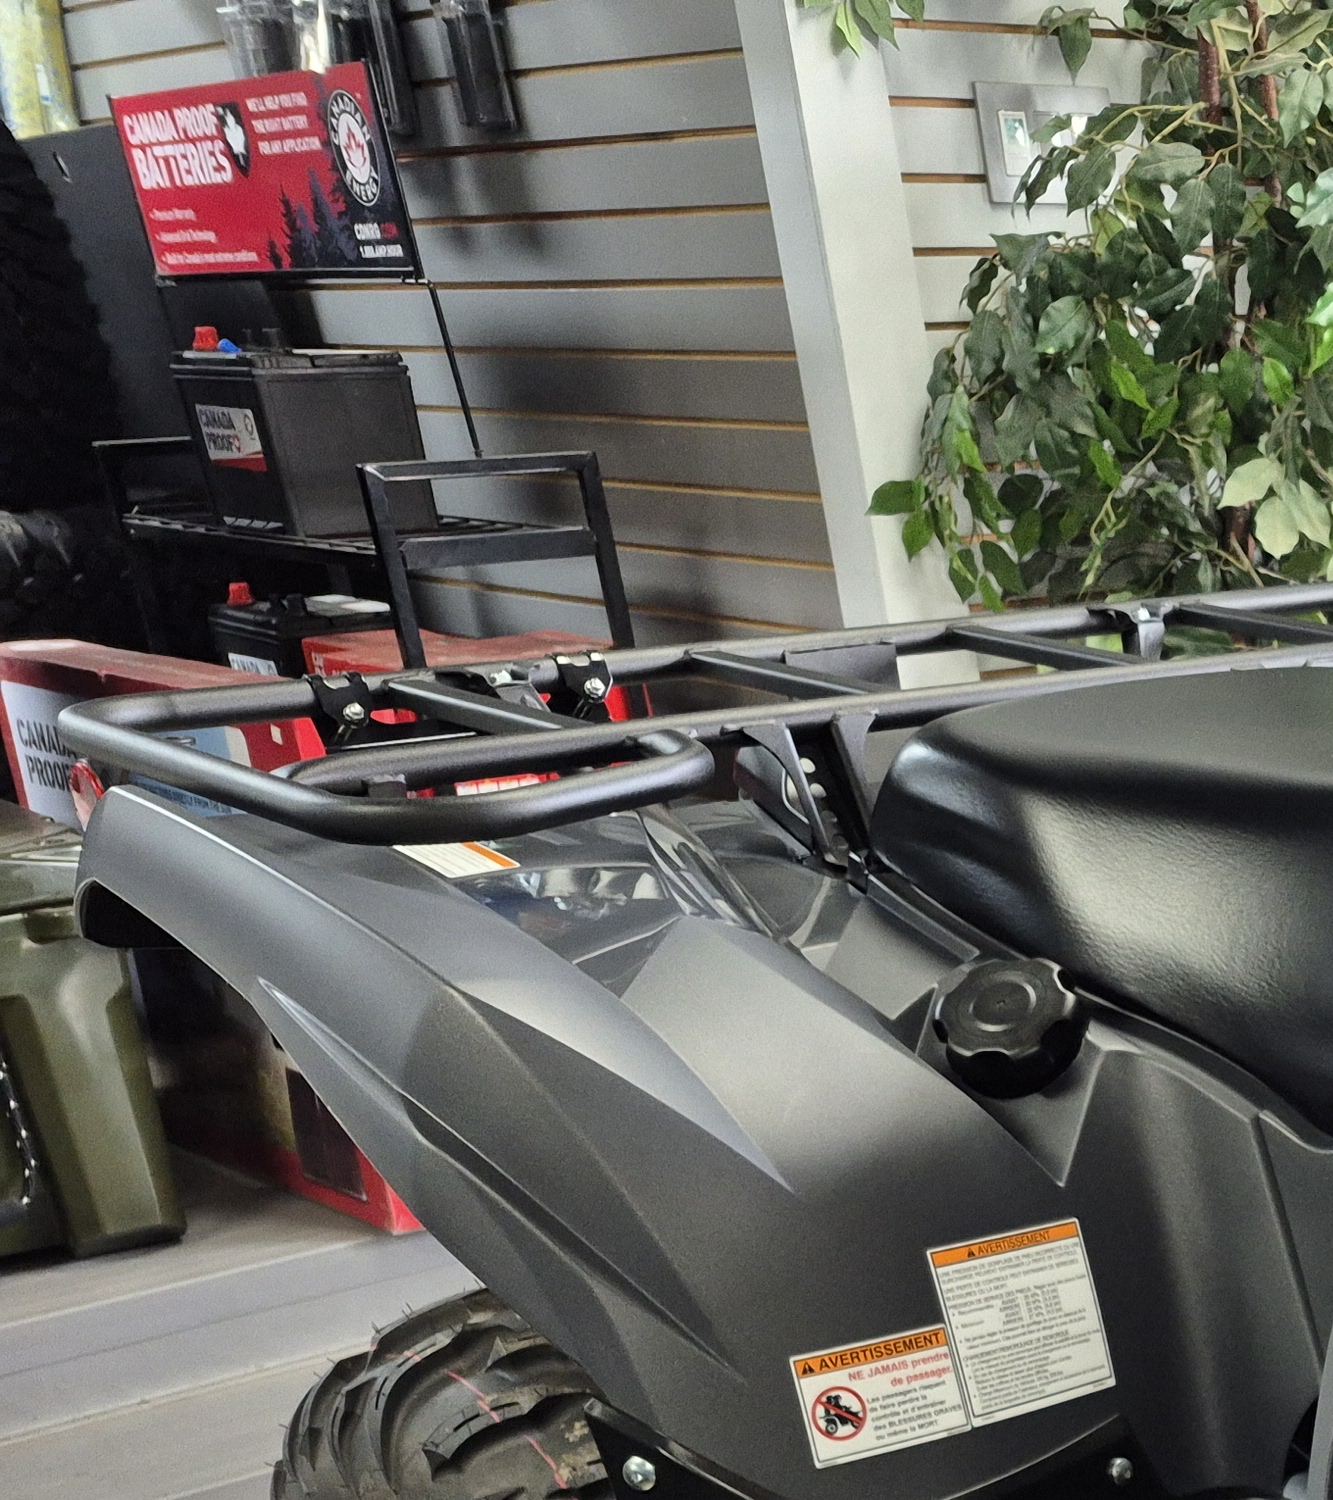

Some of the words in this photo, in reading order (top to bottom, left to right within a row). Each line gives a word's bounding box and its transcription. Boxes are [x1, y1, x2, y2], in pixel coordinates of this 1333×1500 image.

[122, 109, 179, 145] CANADA
[172, 103, 219, 139] PROOF
[329, 95, 375, 146] CANADIAN
[131, 139, 234, 190] BATTERIES
[345, 165, 379, 201] ENERGY
[976, 1229, 1052, 1256] AVERTISSEMENT
[816, 1330, 942, 1372] AVERTISSEMENT
[847, 1369, 865, 1383] NE
[865, 1357, 909, 1379] JAMAIS
[909, 1348, 950, 1370] prendre
[889, 1375, 904, 1387] de
[905, 1365, 954, 1385] passager.
[886, 1410, 933, 1428] BLESSURES
[932, 1402, 963, 1417] GRAVES
